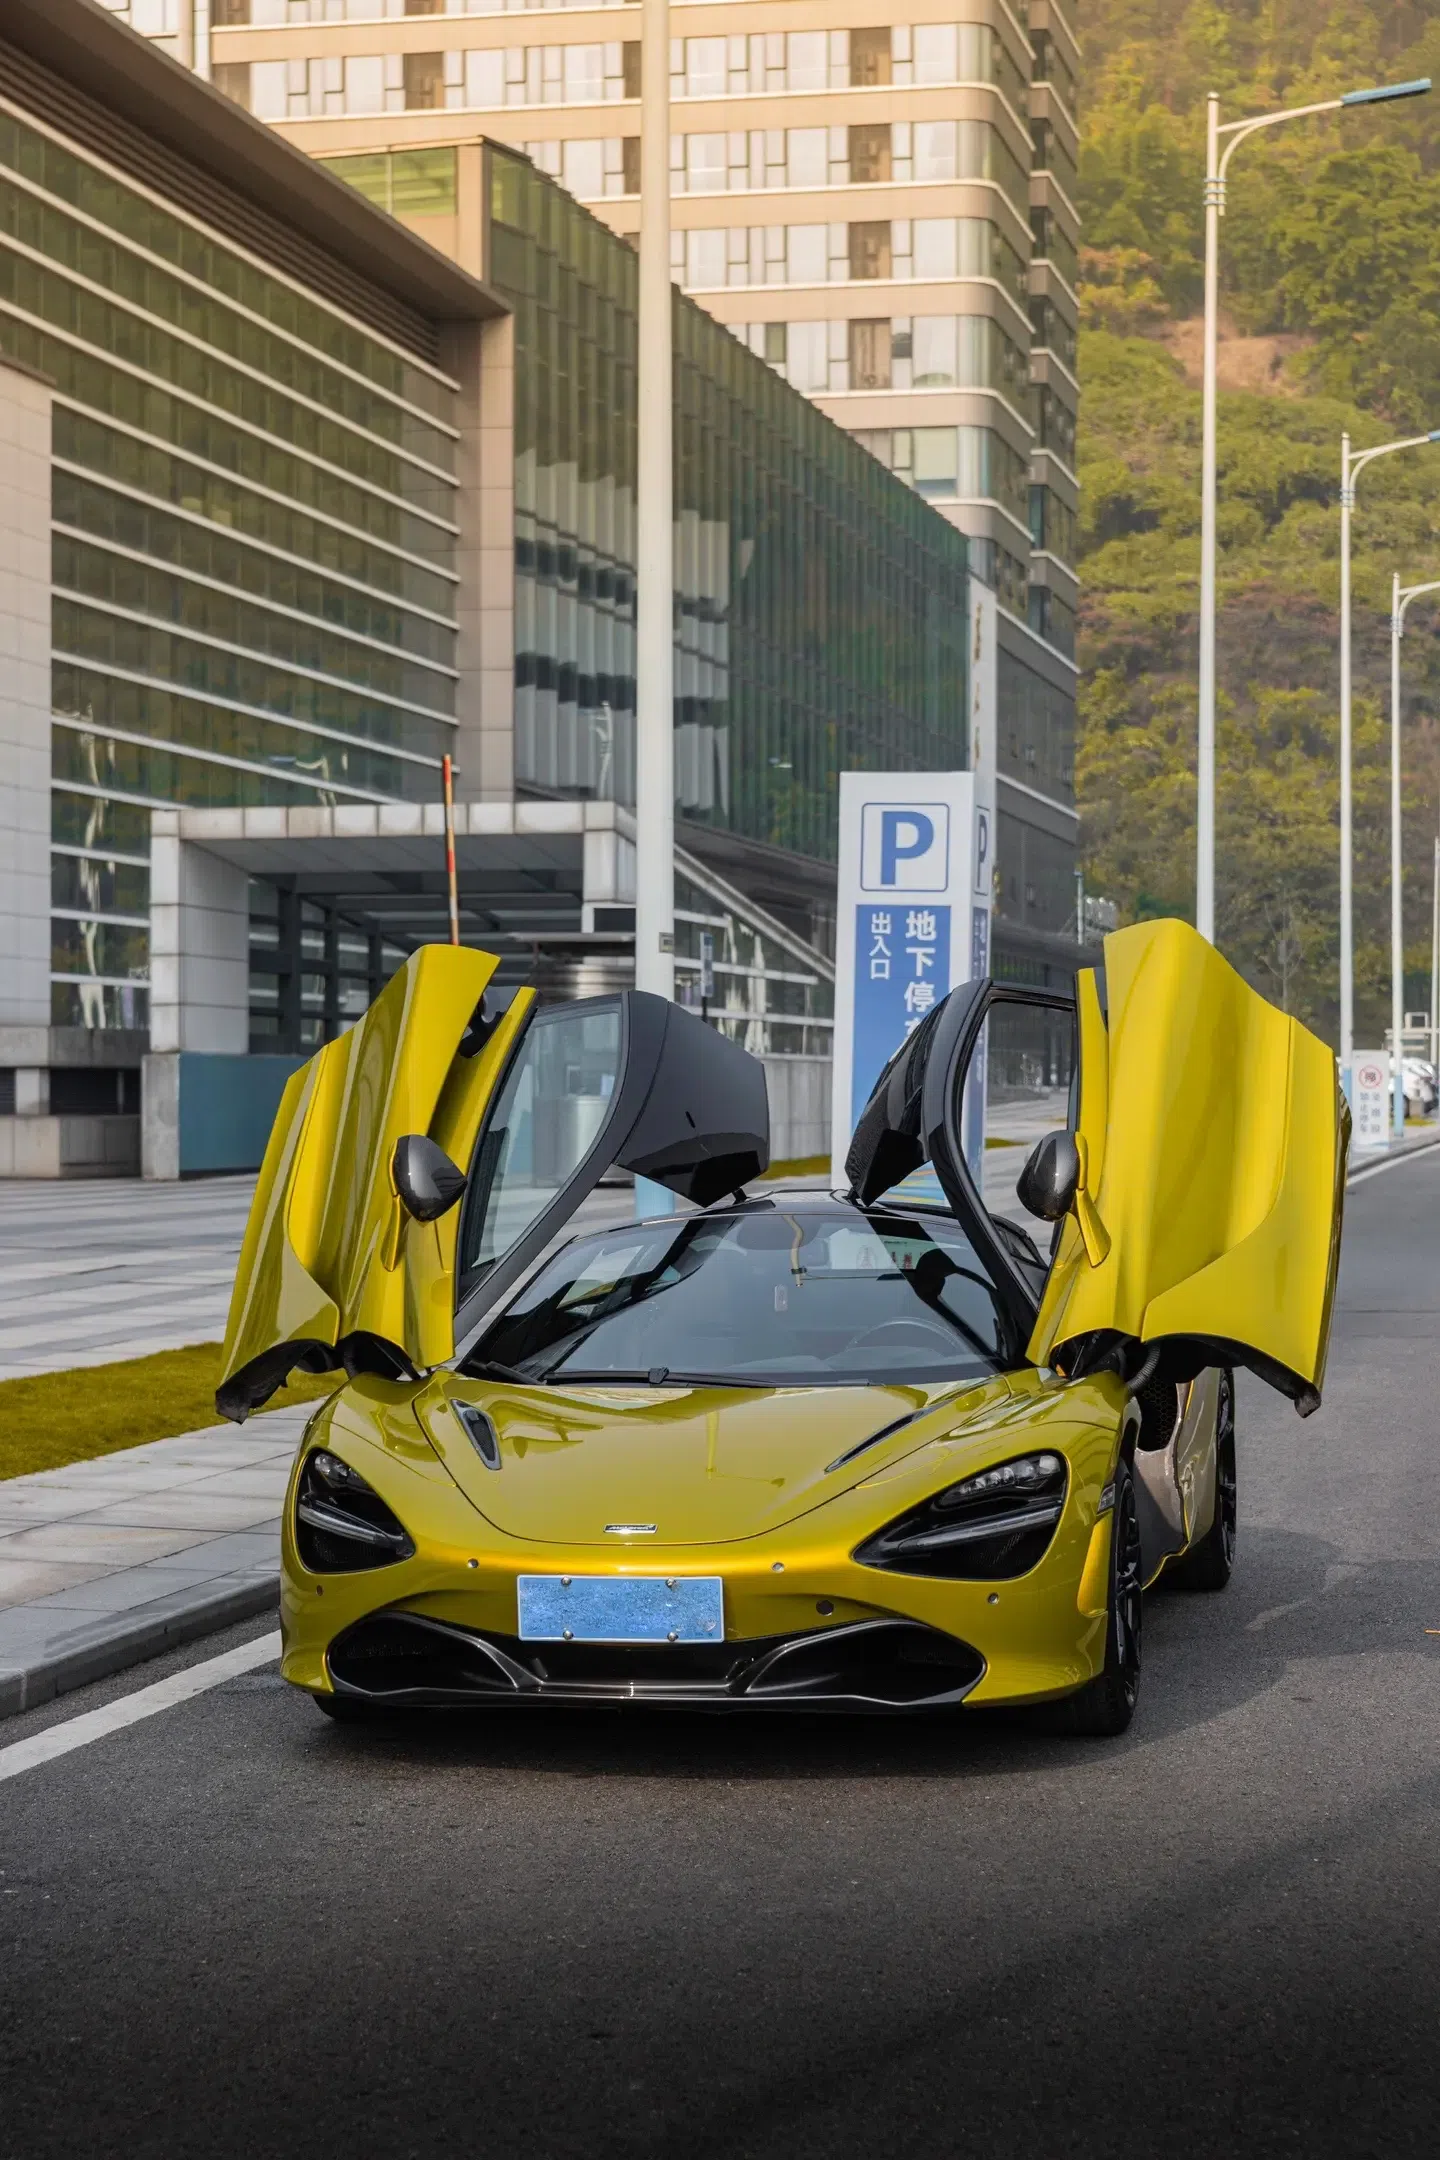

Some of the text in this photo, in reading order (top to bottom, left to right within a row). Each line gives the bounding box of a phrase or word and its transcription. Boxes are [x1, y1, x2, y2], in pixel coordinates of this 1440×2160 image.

[881, 811, 934, 885] P
[977, 814, 987, 888] P
[869, 911, 892, 980] 出入口
